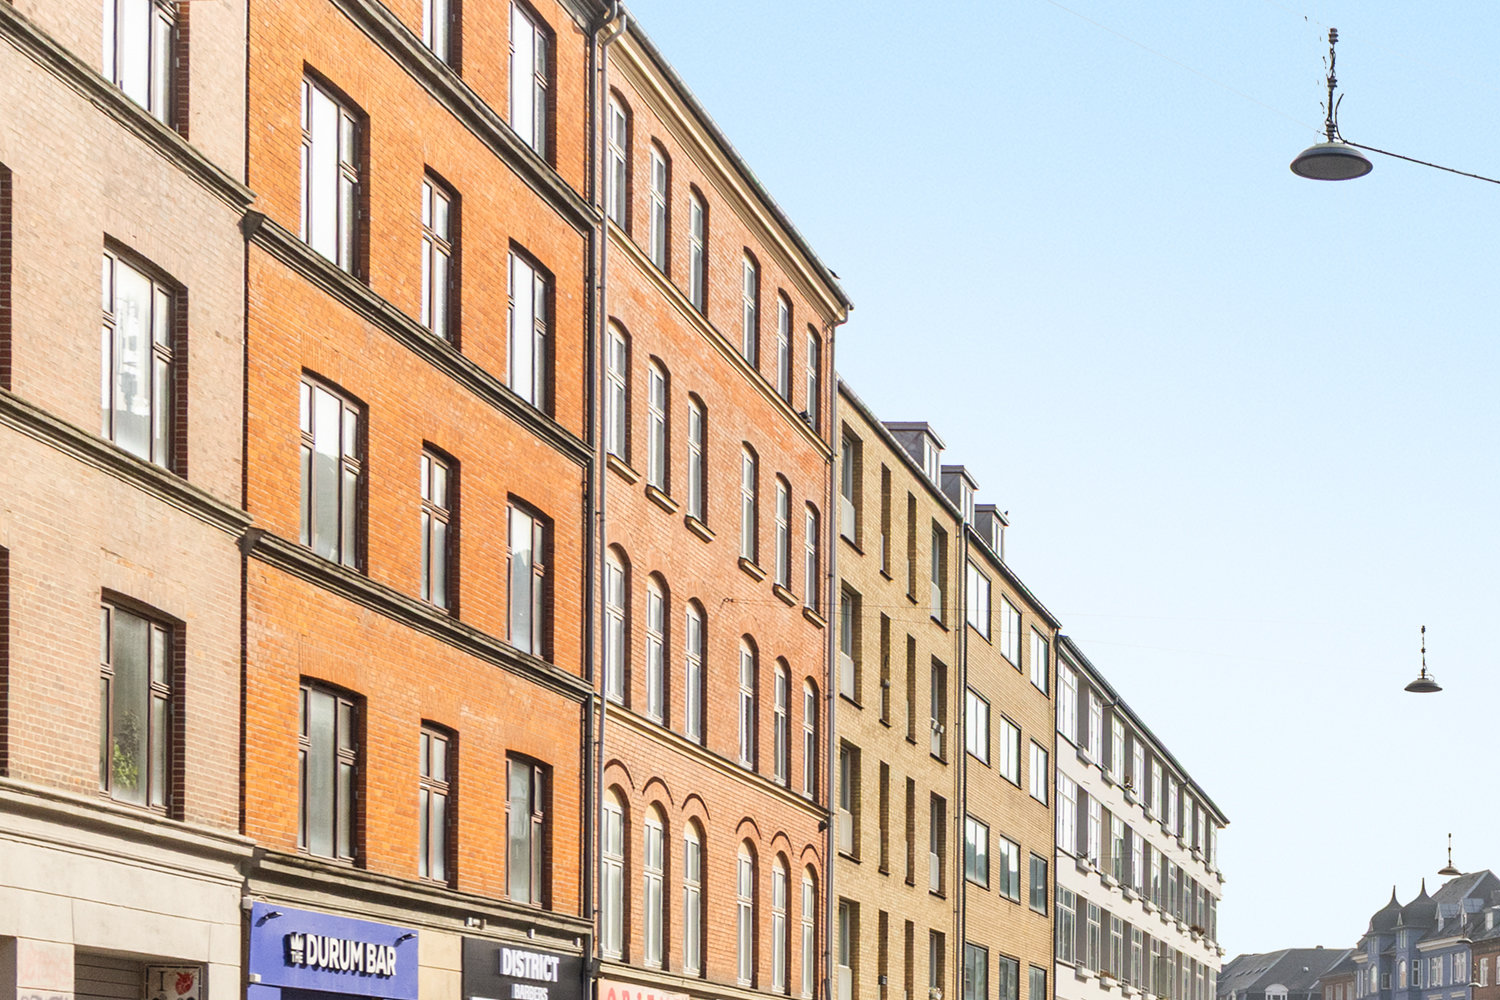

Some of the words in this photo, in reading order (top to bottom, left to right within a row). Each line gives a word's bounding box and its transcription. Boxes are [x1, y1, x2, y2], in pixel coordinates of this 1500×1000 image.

[306, 934, 364, 971] DURUM
[366, 943, 397, 976] BAR
[500, 947, 559, 982] DISTRICT
